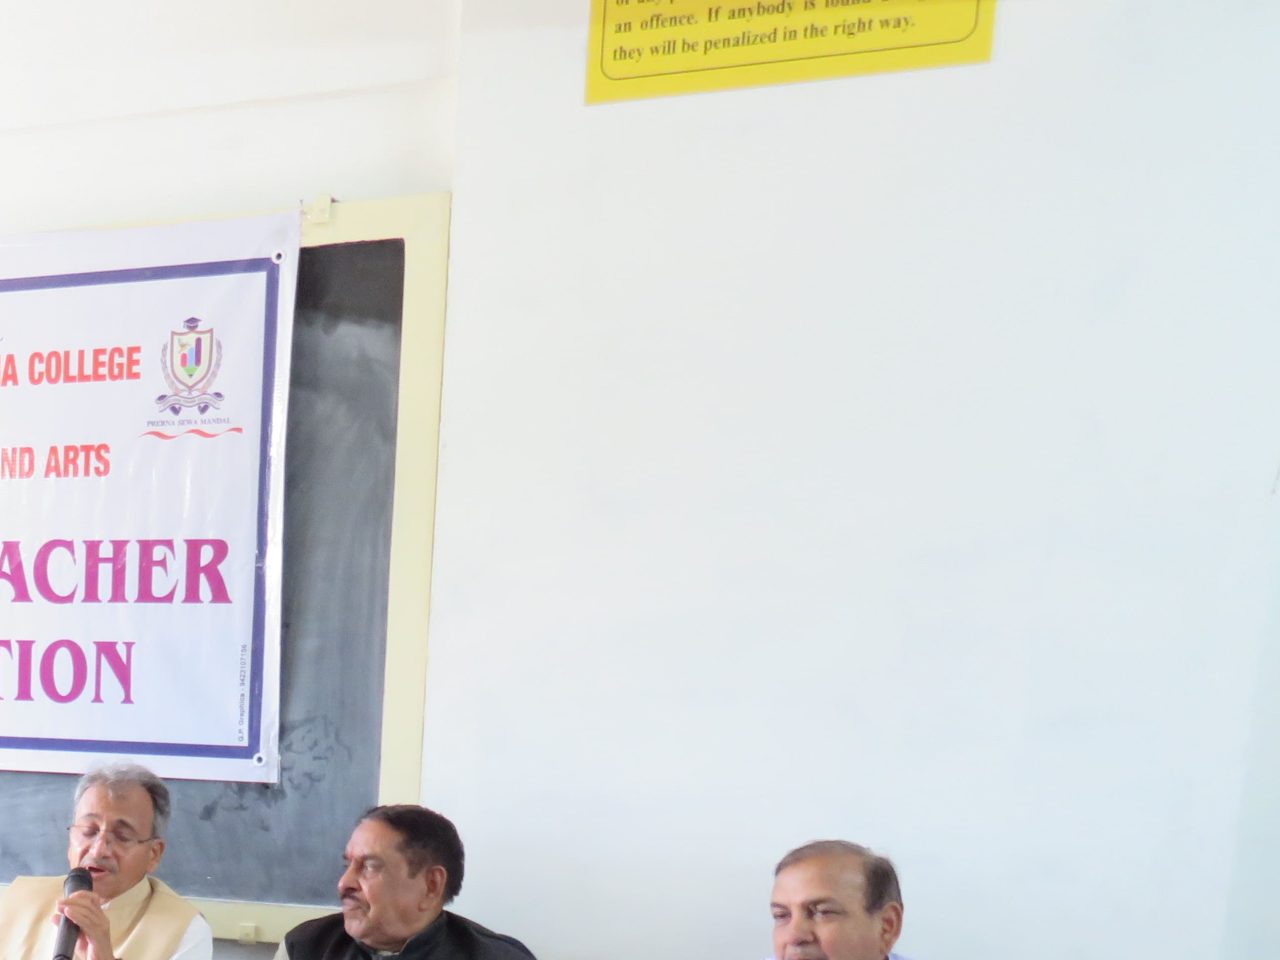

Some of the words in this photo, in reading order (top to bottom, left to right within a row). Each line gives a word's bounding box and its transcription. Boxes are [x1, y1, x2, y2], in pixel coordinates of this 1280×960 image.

[615, 21, 632, 34] an
[640, 13, 698, 30] offence.
[708, 7, 722, 22] If
[728, 0, 794, 23] anybody
[804, 0, 816, 10] is
[613, 46, 644, 62] they
[650, 40, 676, 56] will
[682, 38, 699, 53] be
[704, 27, 778, 55] penalized
[783, 28, 798, 42] in
[804, 22, 828, 39] the
[833, 16, 873, 38] right
[879, 15, 916, 33] way.
[28, 346, 141, 386] COLLEGE
[44, 443, 111, 478] ARTS
